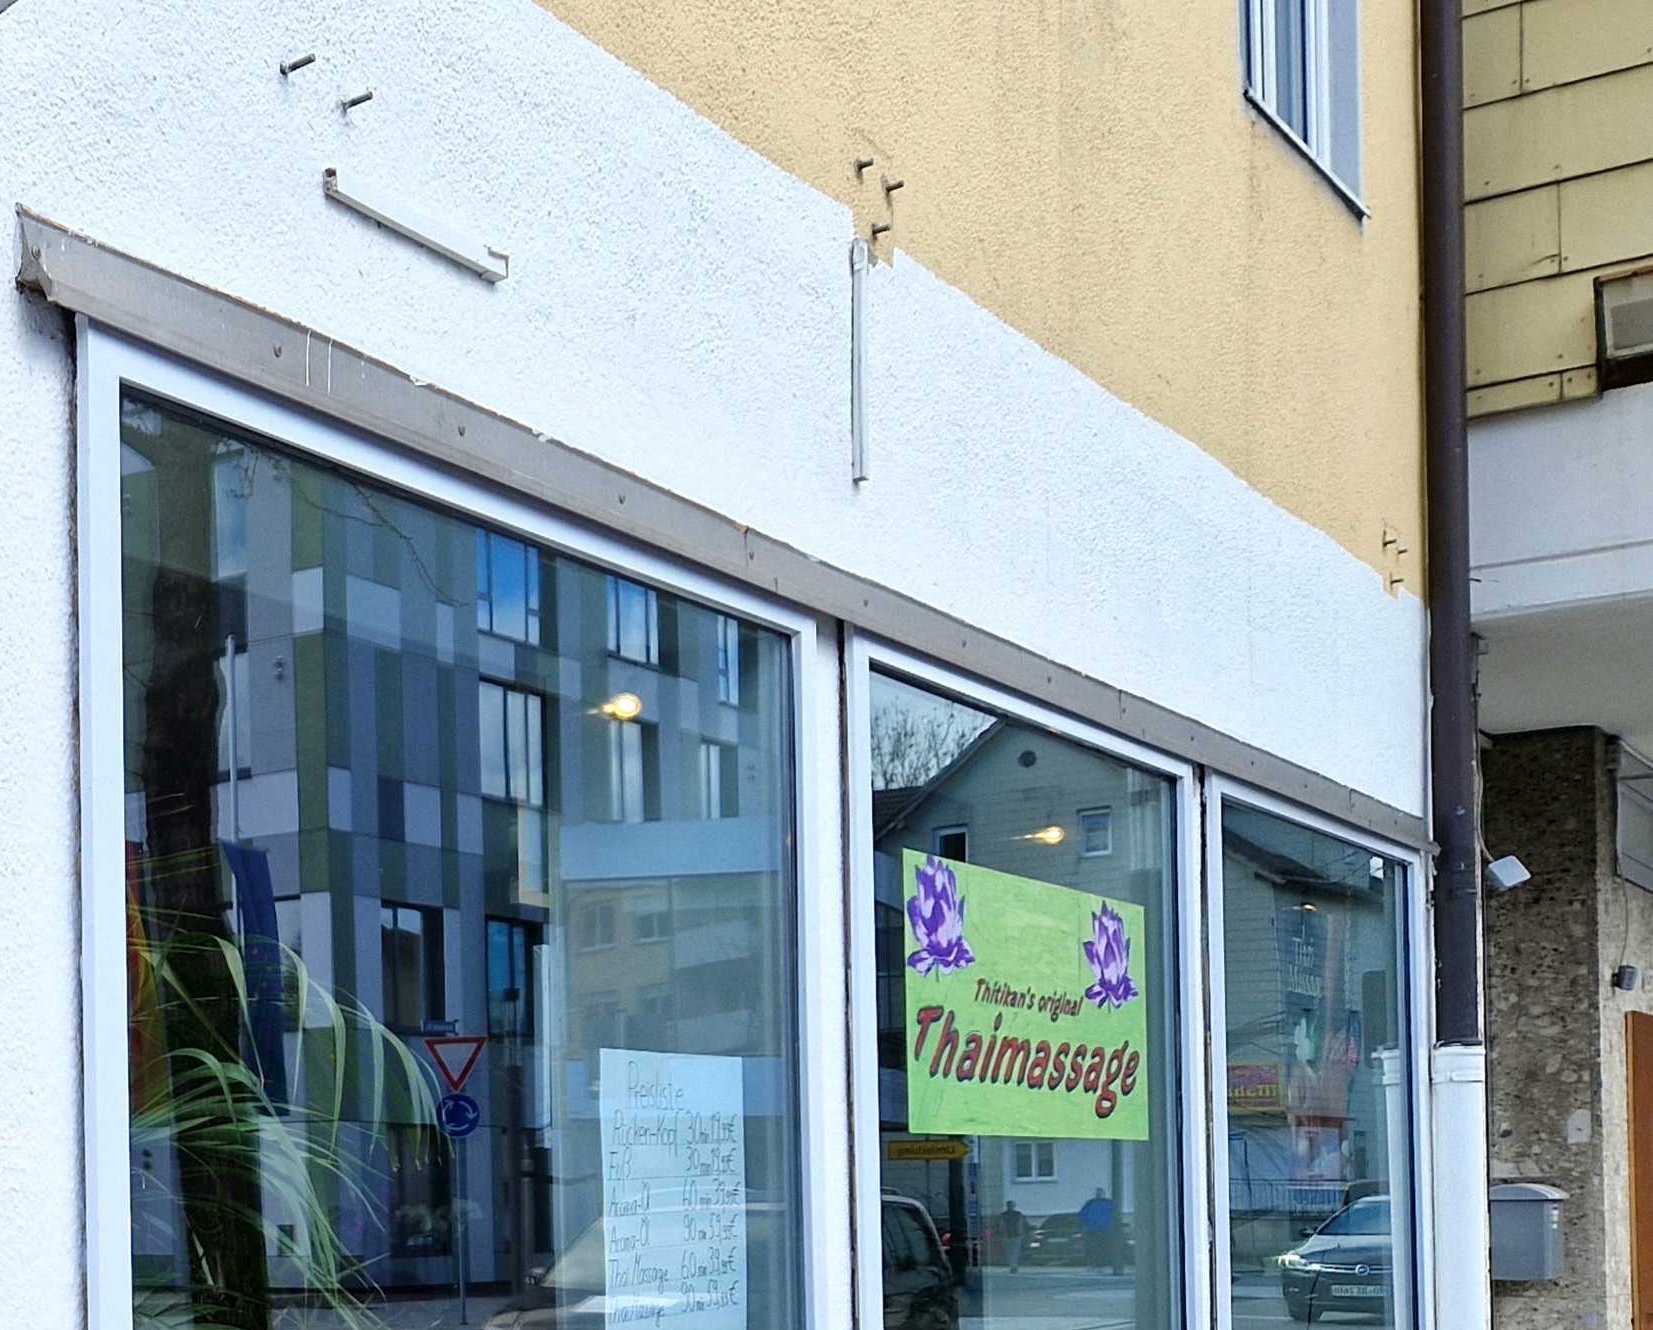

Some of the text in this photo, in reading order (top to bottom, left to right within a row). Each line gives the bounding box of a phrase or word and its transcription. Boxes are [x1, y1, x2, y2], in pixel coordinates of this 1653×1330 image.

[975, 978, 1084, 1022] Thitikan's original
[628, 1060, 685, 1111] Preisliste
[914, 1005, 1140, 1119] Thaimassage
